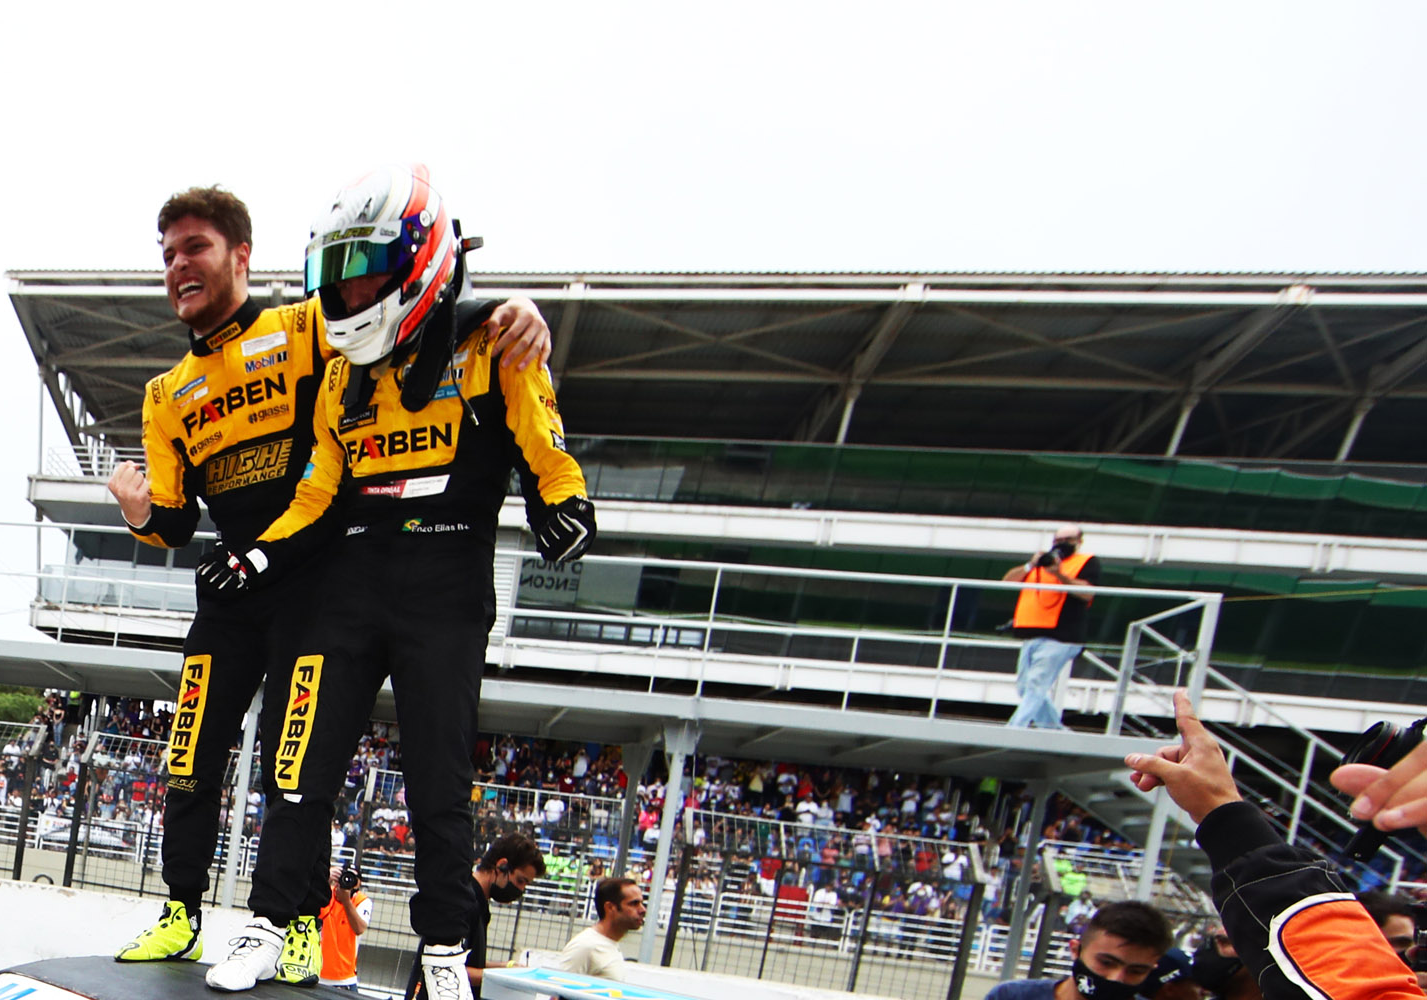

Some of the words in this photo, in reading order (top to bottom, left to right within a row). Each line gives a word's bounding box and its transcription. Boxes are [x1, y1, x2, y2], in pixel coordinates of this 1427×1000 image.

[245, 355, 275, 373] Mobil
[182, 373, 287, 438] FARBEN
[207, 441, 284, 484] HIGH
[346, 423, 452, 463] FARBEN
[170, 663, 203, 768] FARBEN
[278, 665, 314, 780] FARBEN
